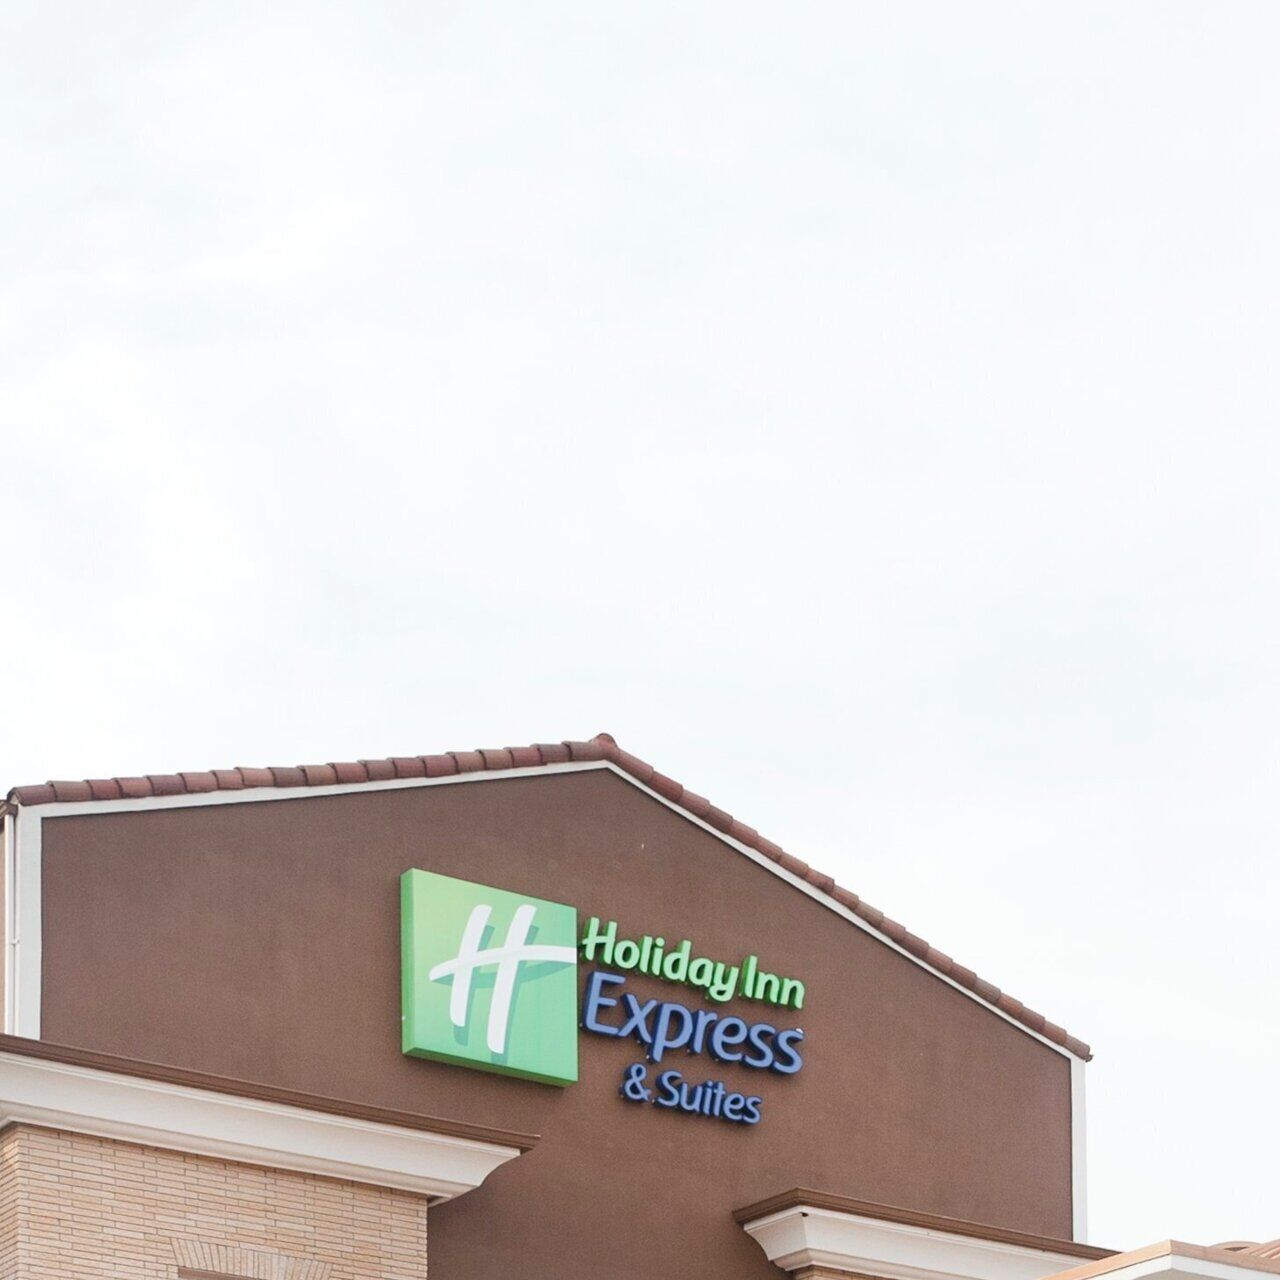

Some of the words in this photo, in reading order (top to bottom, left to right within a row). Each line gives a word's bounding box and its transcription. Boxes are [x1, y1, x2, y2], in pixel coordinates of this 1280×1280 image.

[580, 916, 738, 1002] Holiday
[741, 955, 806, 1009] Inn
[581, 971, 805, 1074] Express
[621, 1063, 651, 1101] &
[655, 1069, 763, 1124] Suites
